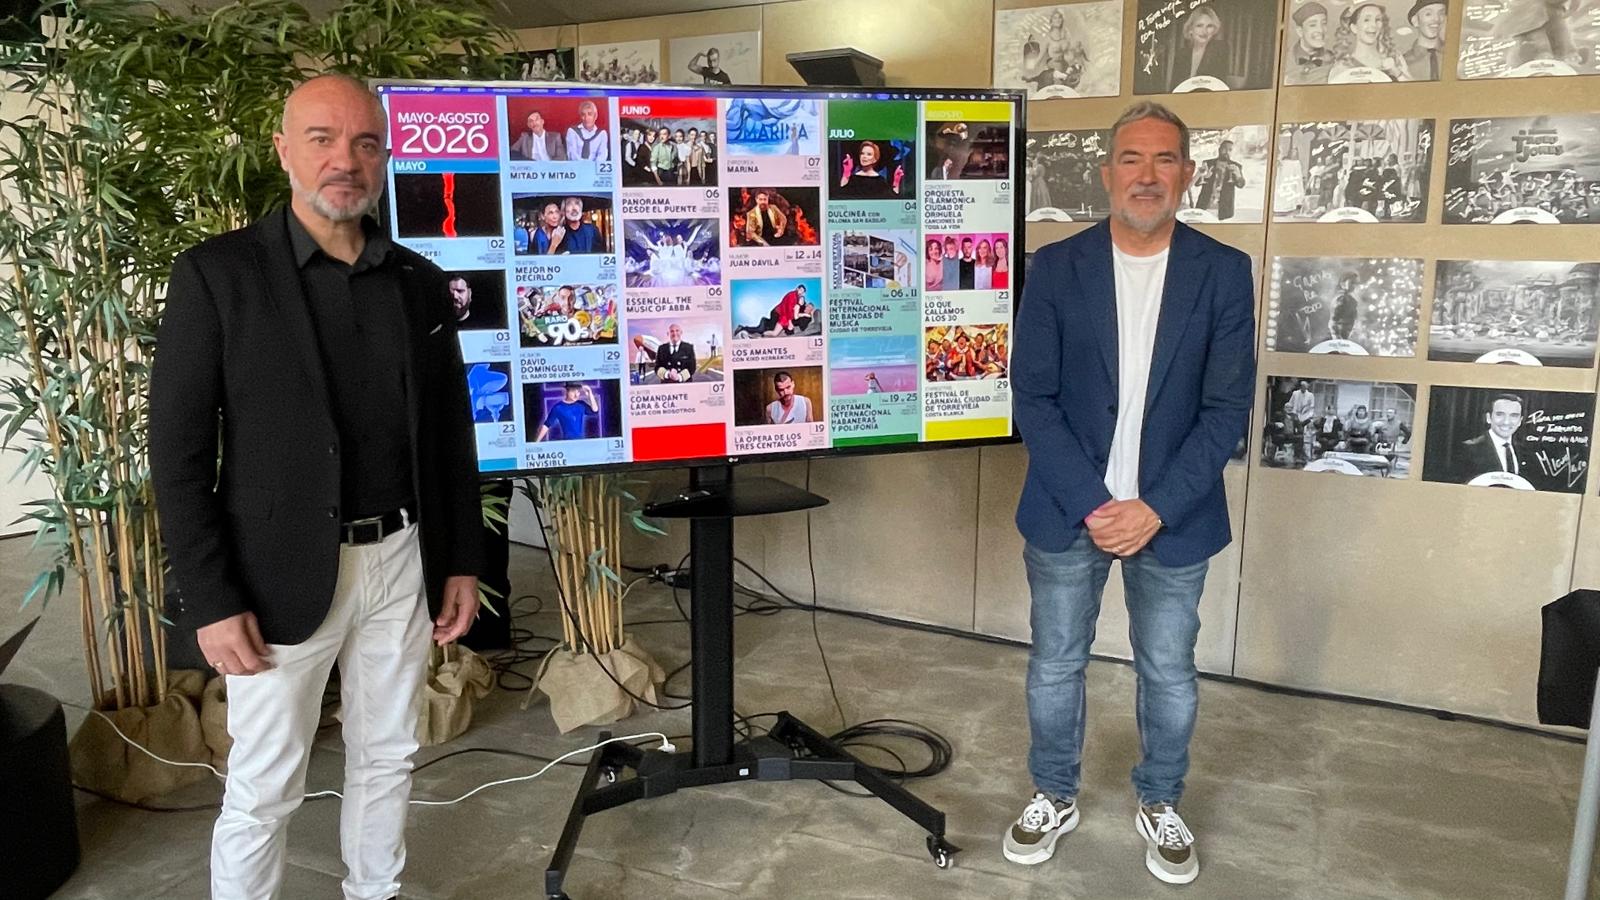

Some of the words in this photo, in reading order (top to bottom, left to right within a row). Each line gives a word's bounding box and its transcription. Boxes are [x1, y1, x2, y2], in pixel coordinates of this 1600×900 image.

[621, 105, 651, 116] JUNIO
[397, 112, 490, 124] MAYO-AGOSTO
[829, 129, 855, 138] JULIO
[401, 124, 490, 154] 2026
[396, 161, 427, 171] MAYO
[808, 158, 820, 167] 07
[600, 164, 613, 173] 23
[1000, 182, 1010, 190] 01
[706, 189, 719, 198] 06
[664, 205, 697, 213] PUENTE
[905, 202, 917, 210] 04
[828, 210, 866, 218] DULCINEA
[490, 240, 505, 248] 02
[796, 250, 805, 259] 12
[813, 250, 822, 259] 14
[603, 256, 616, 265] 24
[515, 266, 545, 274] MEJOR
[516, 274, 554, 282] DECIRLO
[708, 288, 722, 296] 06
[891, 289, 903, 297] 06
[676, 296, 692, 304] THE
[627, 305, 653, 313] MUSIC
[830, 305, 890, 313] INTERNACIONAL
[496, 332, 510, 341] 03
[814, 338, 823, 347] 13
[607, 351, 620, 360] 29
[712, 384, 725, 392] 07
[997, 381, 1008, 389] 29
[630, 394, 688, 403] COMANDANTE
[890, 394, 899, 402] 19
[906, 393, 918, 401] 25
[937, 403, 979, 411] TORREVIEJA
[831, 410, 891, 418] INTERNACIONAL
[502, 424, 516, 434] 23
[815, 424, 824, 432] 19
[615, 440, 624, 449] 31
[757, 440, 797, 449] CENTAVOS
[538, 452, 564, 460] MAGO
[526, 459, 567, 468] INVISIBLE
